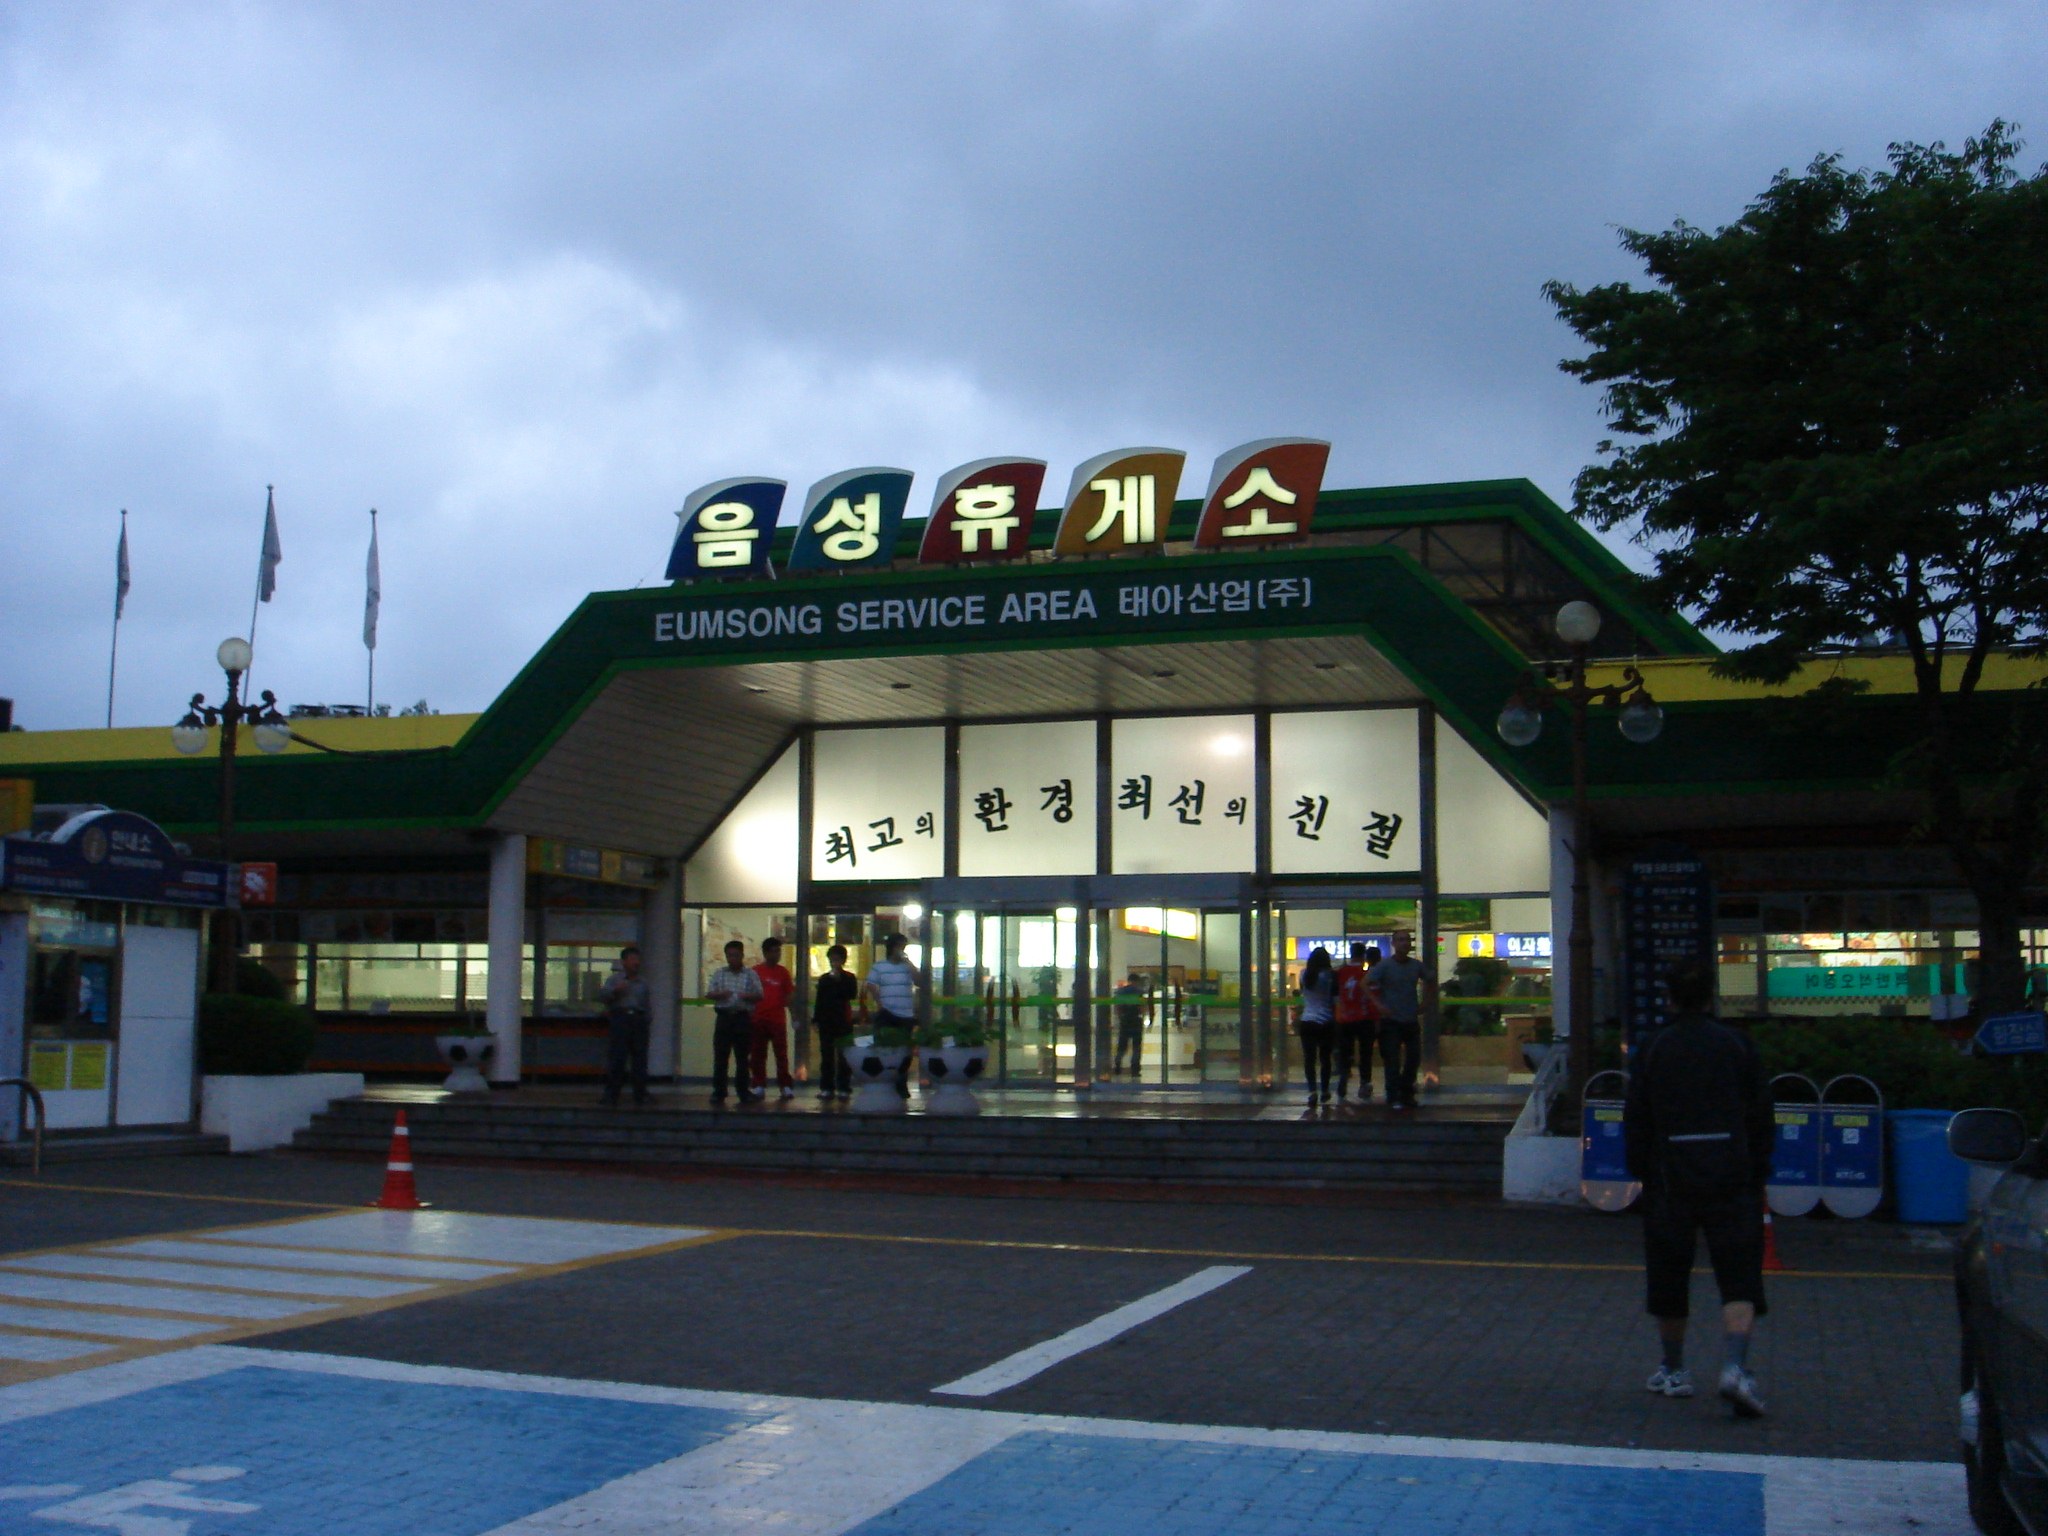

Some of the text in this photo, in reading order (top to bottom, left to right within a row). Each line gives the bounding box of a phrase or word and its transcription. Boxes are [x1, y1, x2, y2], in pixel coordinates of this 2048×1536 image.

[655, 588, 1097, 642] EUMSONG SERVICE AREA
[826, 774, 1403, 867] 최고의 환경 최선의 친절
